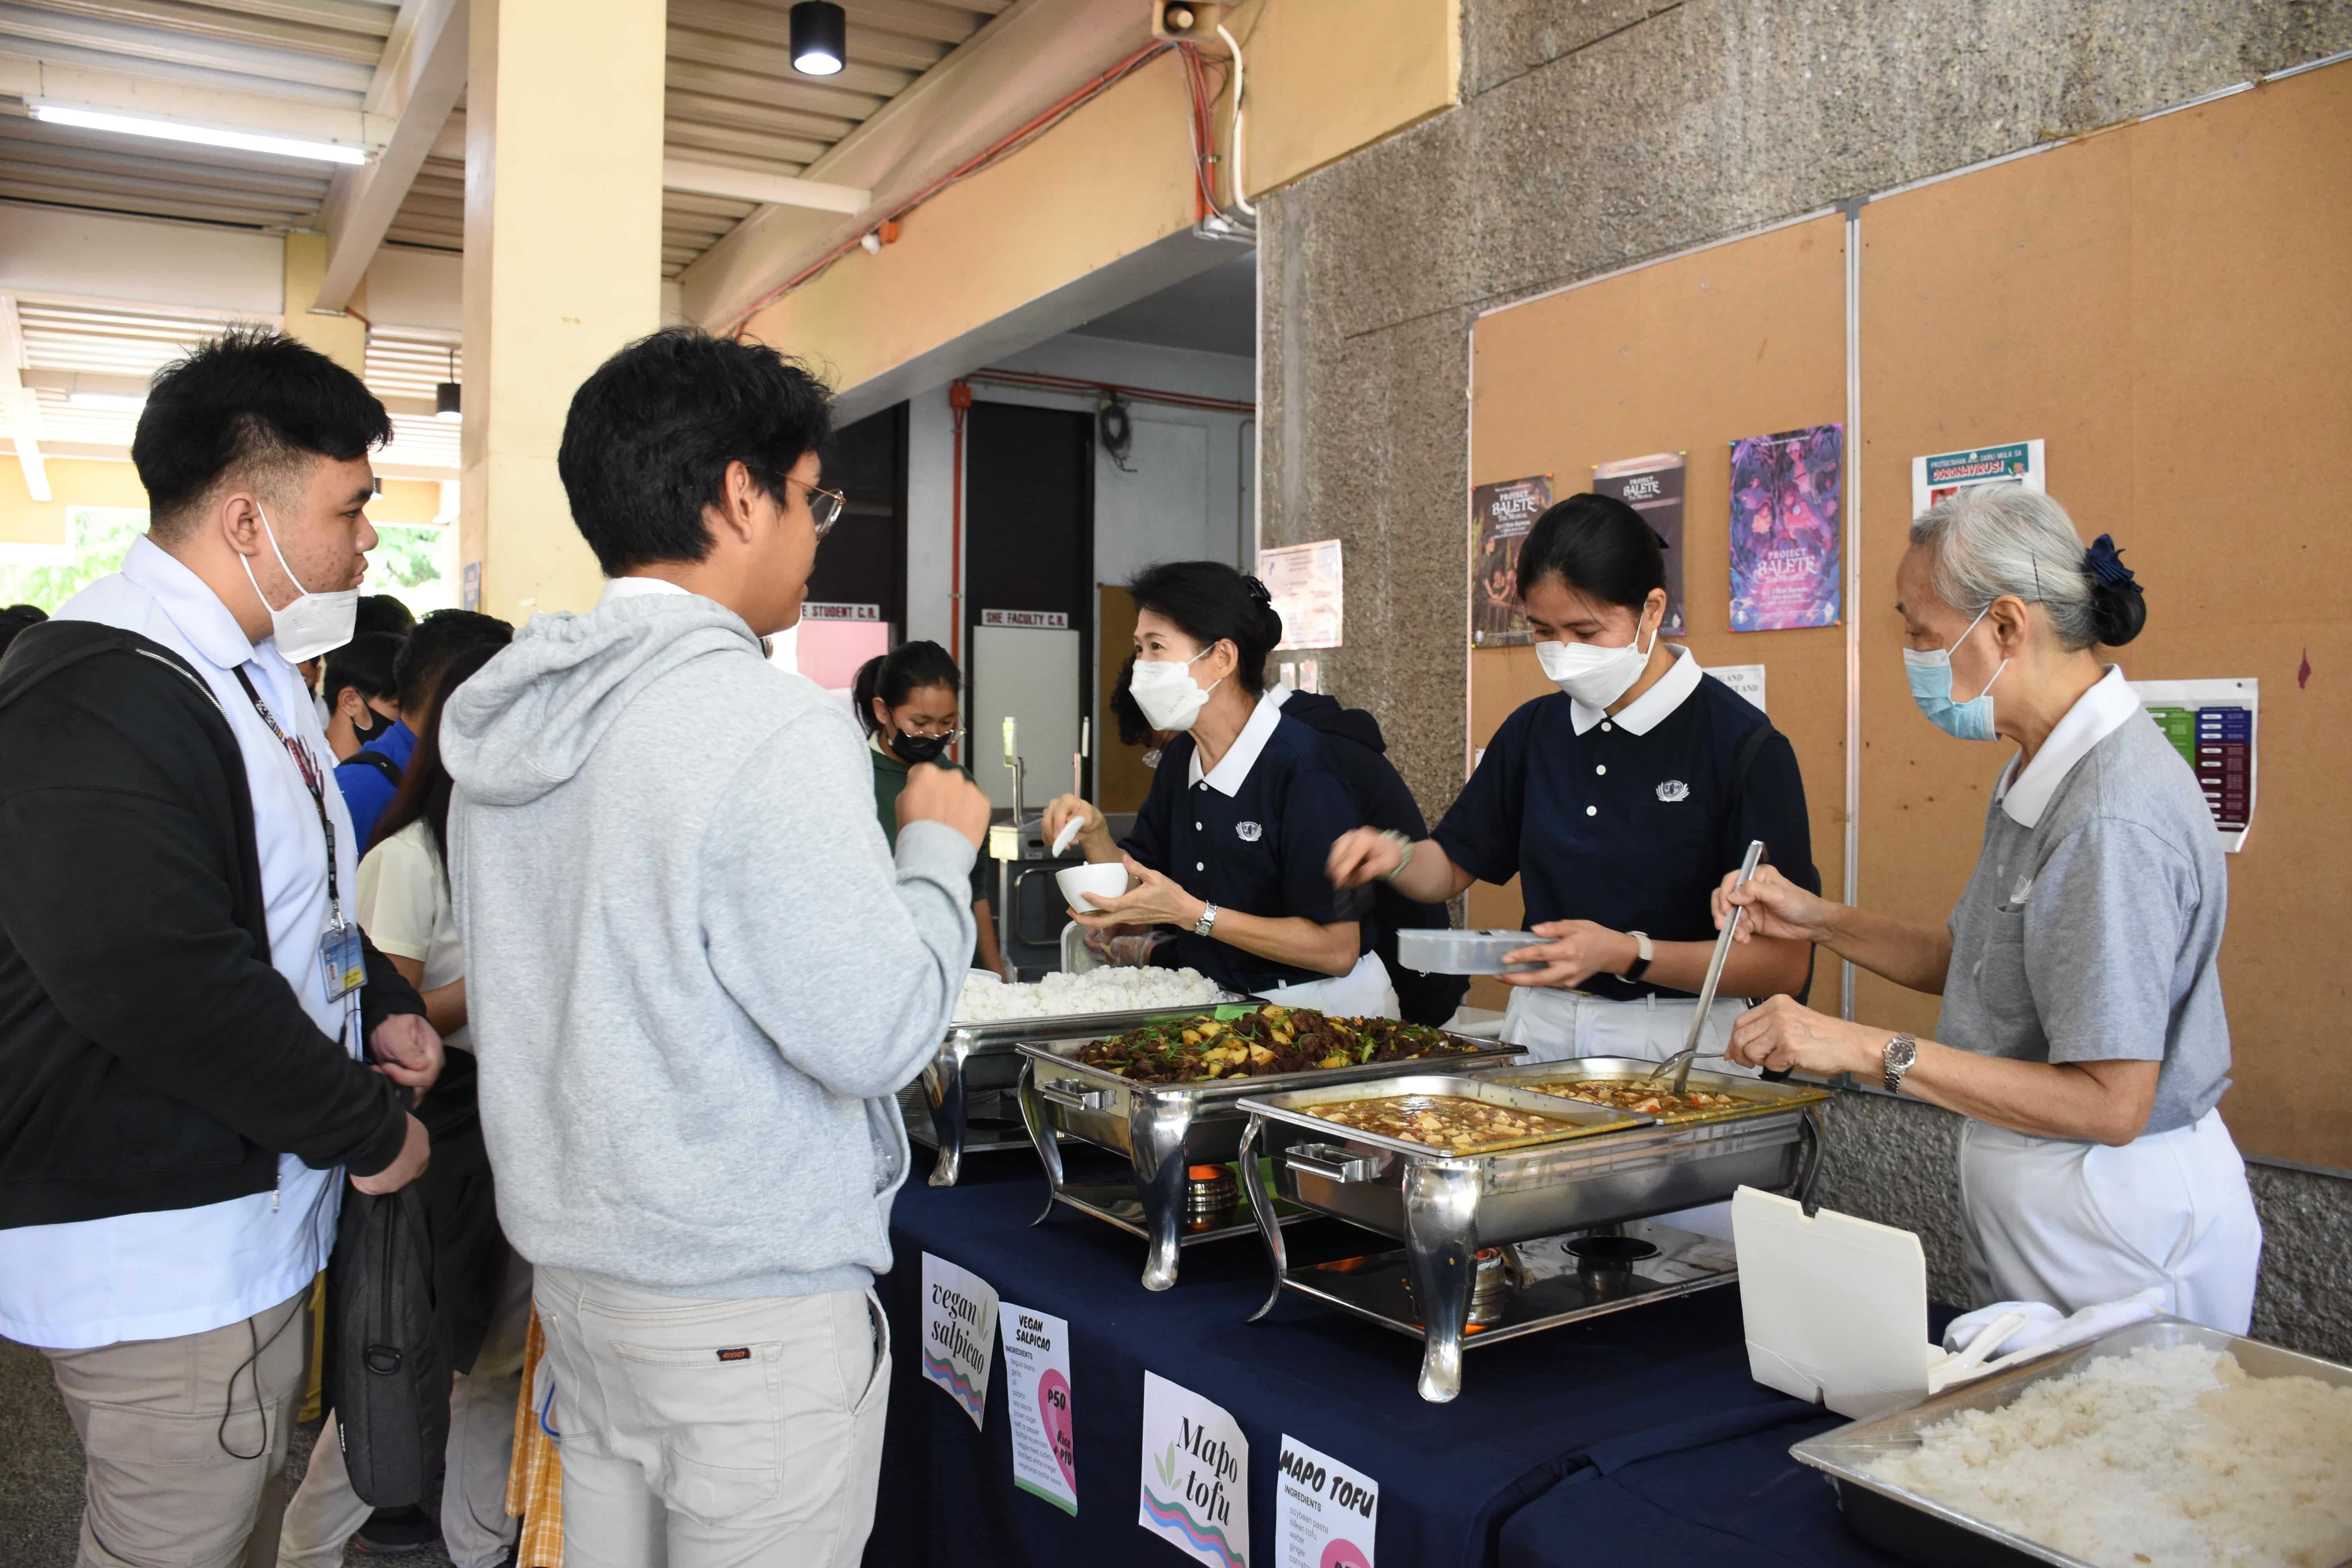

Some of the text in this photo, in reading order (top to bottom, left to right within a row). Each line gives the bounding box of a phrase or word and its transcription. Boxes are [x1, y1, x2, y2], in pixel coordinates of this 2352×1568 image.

[1932, 460, 2005, 481] CORONAVIRUS!
[1500, 490, 1528, 501] PROJECT
[1623, 481, 1661, 496] BALETE
[1492, 497, 1537, 515] BALETE
[1768, 548, 1806, 560] PROJECT
[1756, 556, 1818, 577] BALETE
[812, 606, 853, 617] STUDENT
[1007, 613, 1044, 624] FACULTY
[933, 1283, 976, 1325] vegan
[1019, 1314, 1043, 1332] VEGAN
[932, 1321, 984, 1374] salpicao
[1016, 1329, 1050, 1352] SALPICAO
[1005, 1345, 1033, 1360] INGREDIENTS
[1012, 1369, 1022, 1378] garlic
[1024, 1363, 1035, 1372] beans
[1013, 1390, 1025, 1399] potato
[1020, 1403, 1032, 1412] sauce
[1013, 1410, 1036, 1424] brown sugar
[1026, 1425, 1040, 1436] pepper
[1016, 1430, 1049, 1450] button mushroom
[1057, 1430, 1071, 1449] Rice
[1016, 1441, 1029, 1452] veggie
[1029, 1445, 1039, 1455] meat
[1176, 1416, 1237, 1483] Mapo
[1018, 1462, 1062, 1486] vegetarian oyster sauce
[1043, 1462, 1056, 1474] vinegar
[1279, 1449, 1375, 1518] MAPO TOFU
[1186, 1469, 1230, 1526] tofu
[1284, 1484, 1321, 1512] INGREDIENTS
[1290, 1507, 1328, 1534] soybean paste
[1290, 1518, 1317, 1540] silken tofu
[1290, 1531, 1305, 1545] water
[1289, 1543, 1305, 1557] ginger
